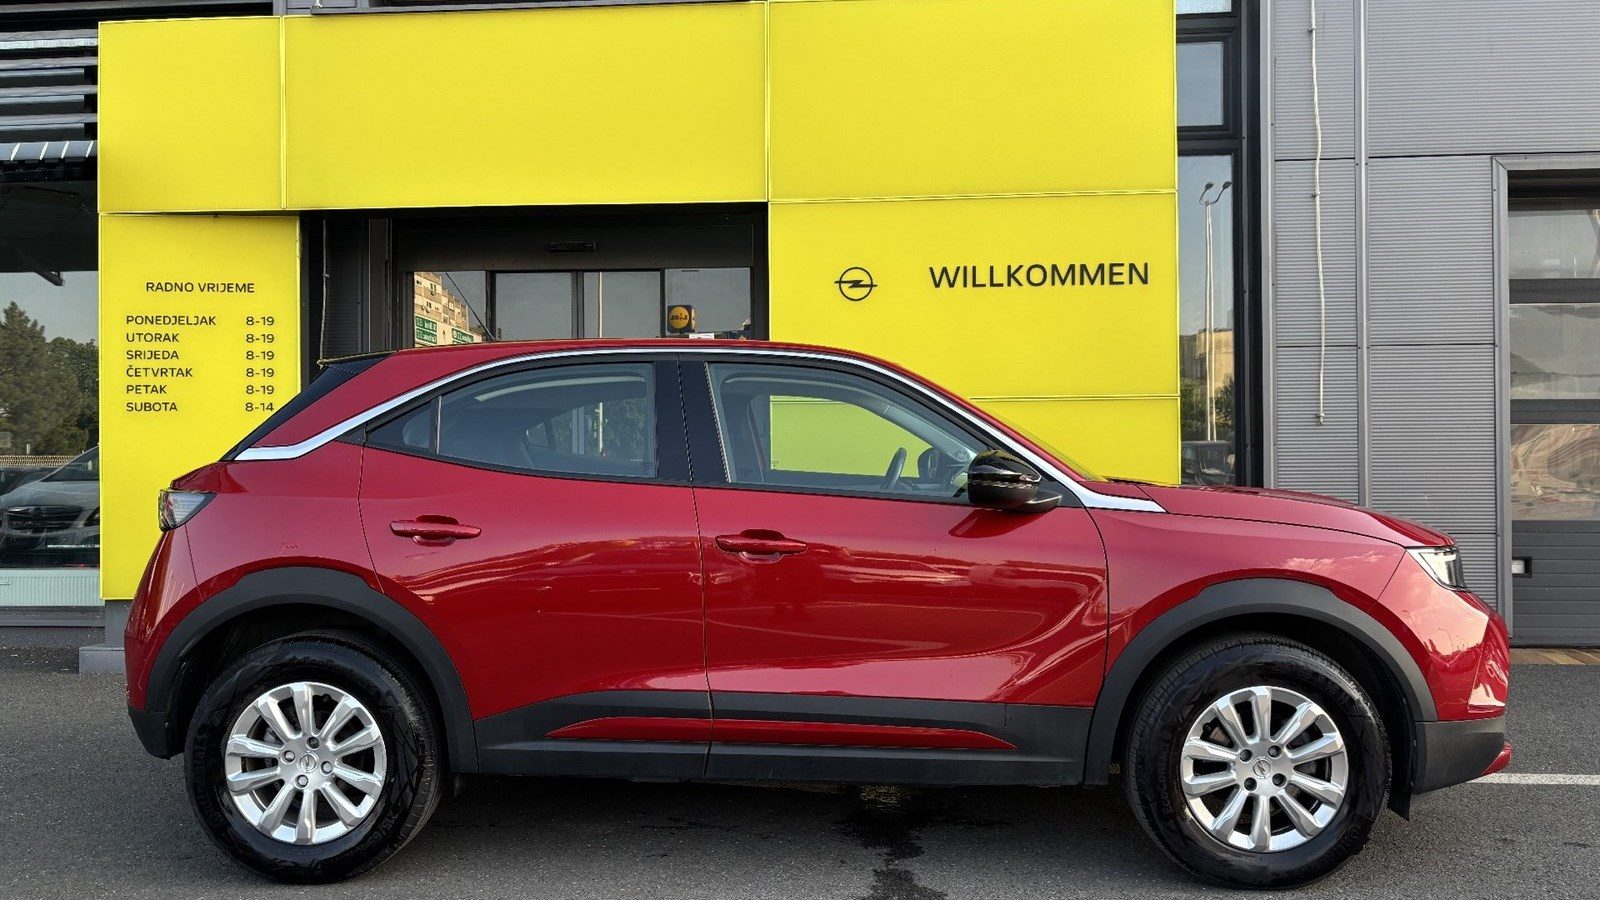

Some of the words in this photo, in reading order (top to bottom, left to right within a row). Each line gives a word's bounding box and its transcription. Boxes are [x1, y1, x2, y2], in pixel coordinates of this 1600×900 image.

[929, 262, 1149, 288] WILLKOMMEN
[146, 281, 194, 293] RADNO
[197, 282, 255, 294] VRIJEME
[126, 315, 217, 326] PONEDJELJAK
[245, 316, 275, 326] 8-19
[126, 332, 180, 343] UTORAK
[245, 333, 275, 344] 8-19
[126, 350, 180, 360] SRIJEDA
[245, 350, 275, 361] 8-19
[126, 364, 193, 378] ČETVRTAK
[245, 367, 275, 378] 8-19
[126, 384, 167, 395] PETAK
[245, 384, 275, 395] 8-19
[126, 401, 178, 412] SUBOTA
[245, 401, 275, 412] 8-14
